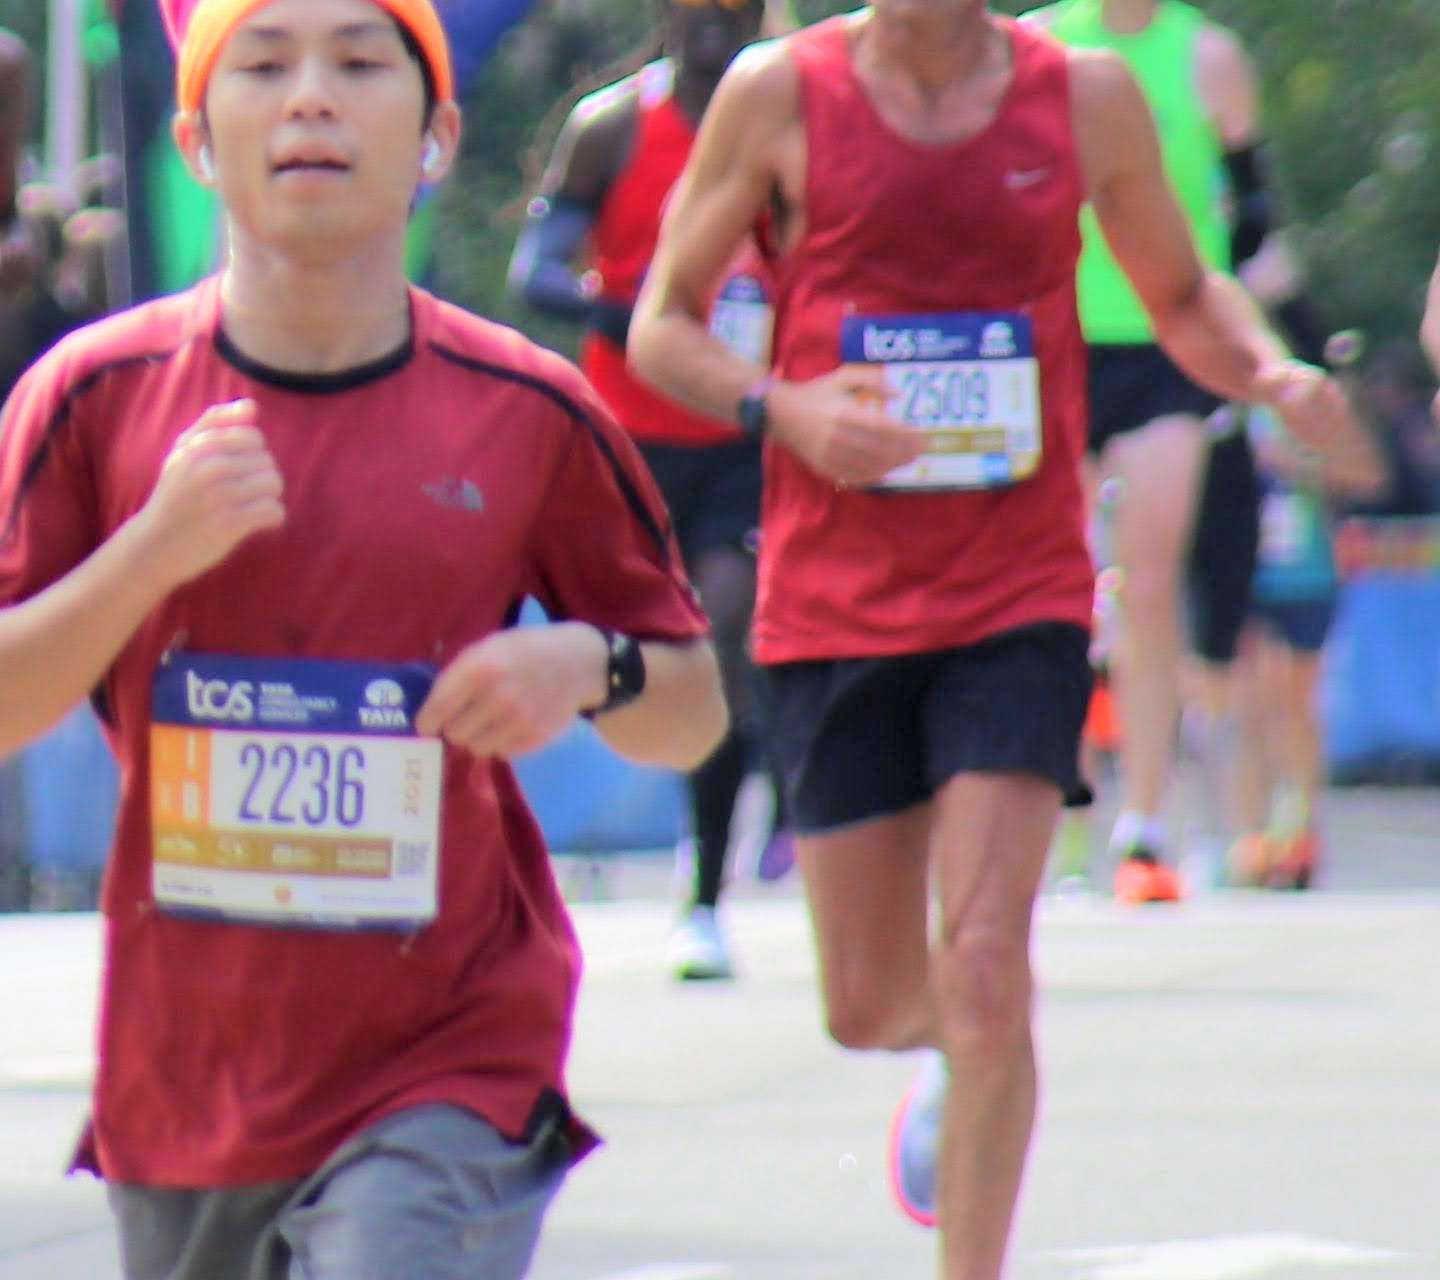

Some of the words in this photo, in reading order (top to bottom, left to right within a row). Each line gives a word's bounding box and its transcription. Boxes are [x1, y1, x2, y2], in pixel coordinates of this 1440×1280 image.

[187, 669, 254, 720] tcs
[358, 706, 407, 727] TATA
[239, 742, 366, 828] 2236
